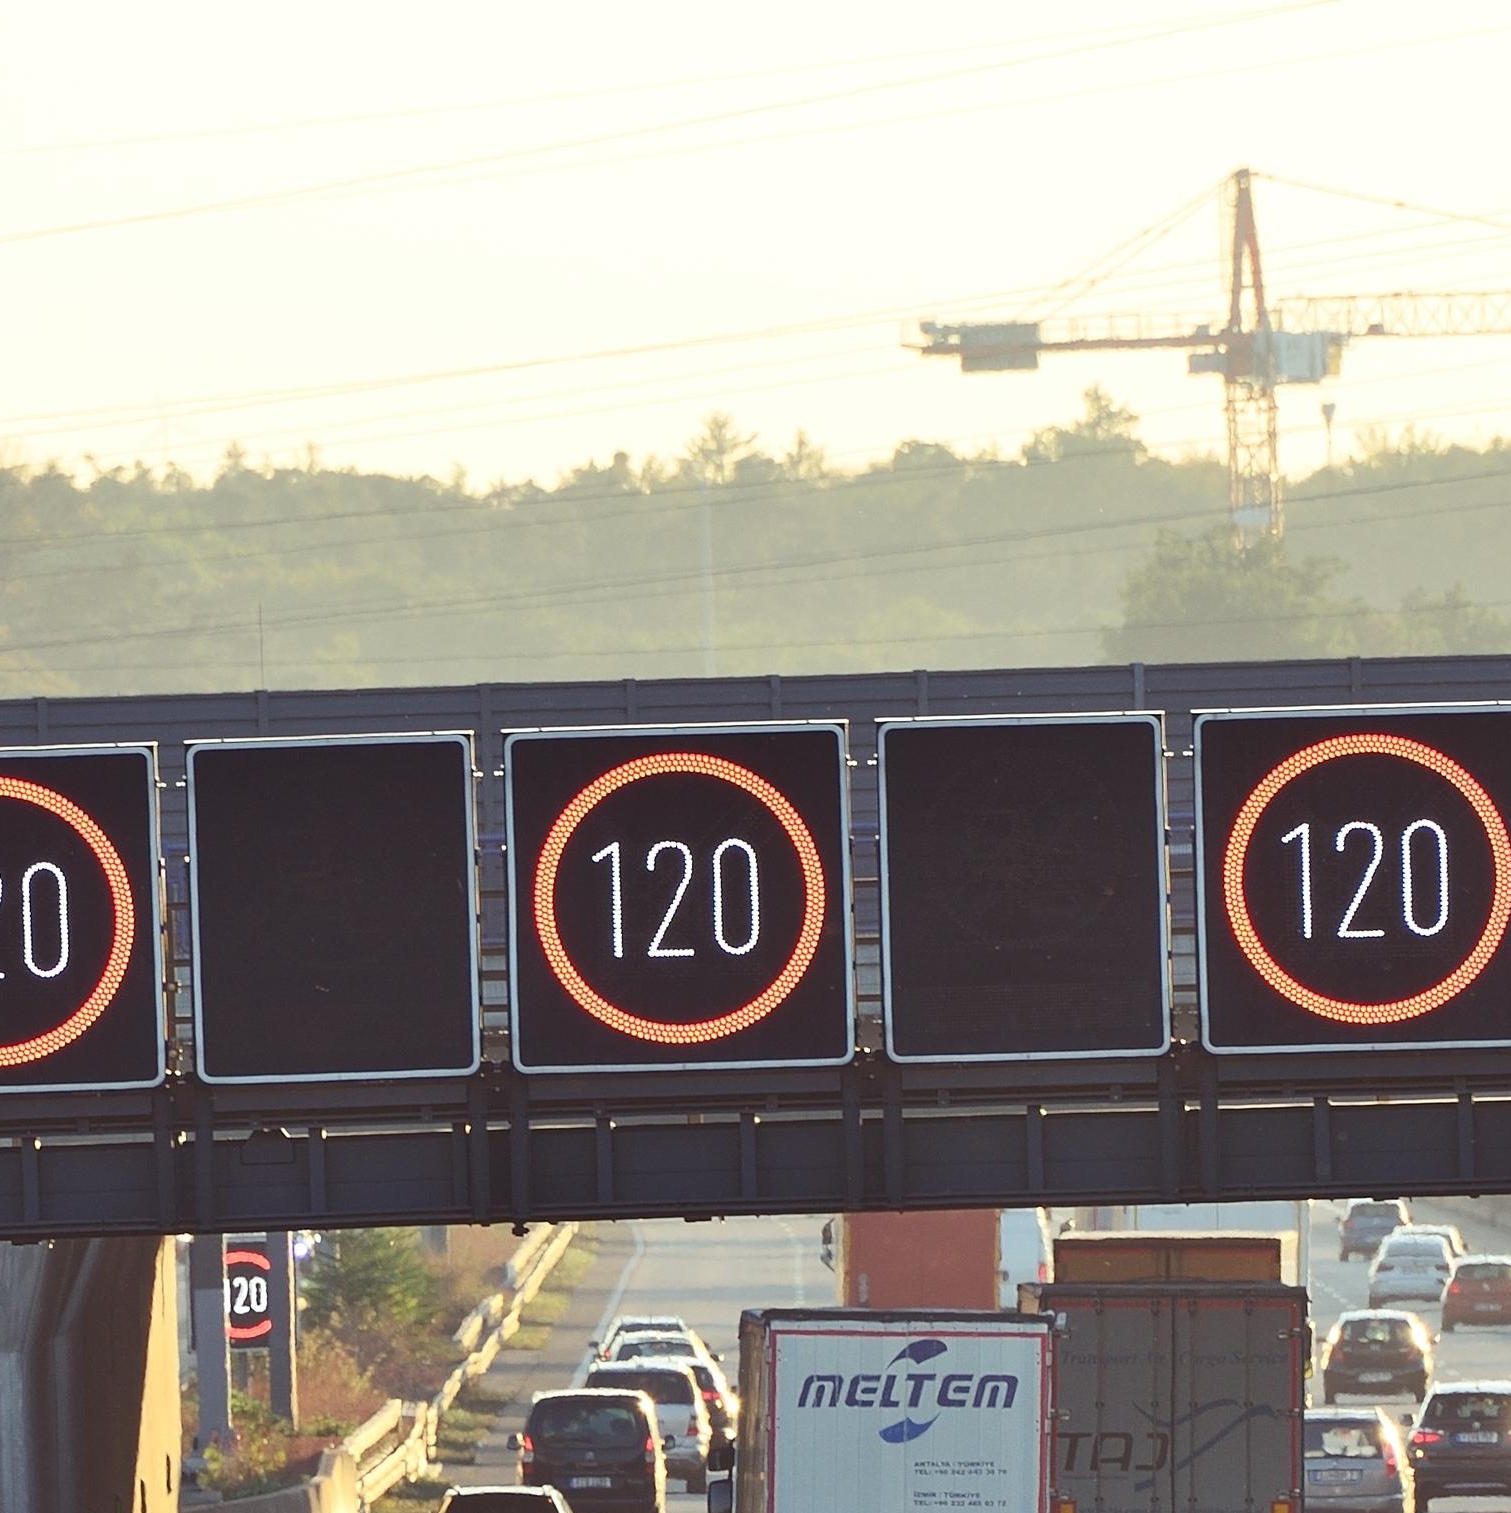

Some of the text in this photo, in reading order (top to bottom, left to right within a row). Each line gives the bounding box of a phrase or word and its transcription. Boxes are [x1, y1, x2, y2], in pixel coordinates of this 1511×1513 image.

[591, 836, 761, 959] 120
[1280, 818, 1450, 939] 120
[797, 1373, 1019, 1408] MELTEM
